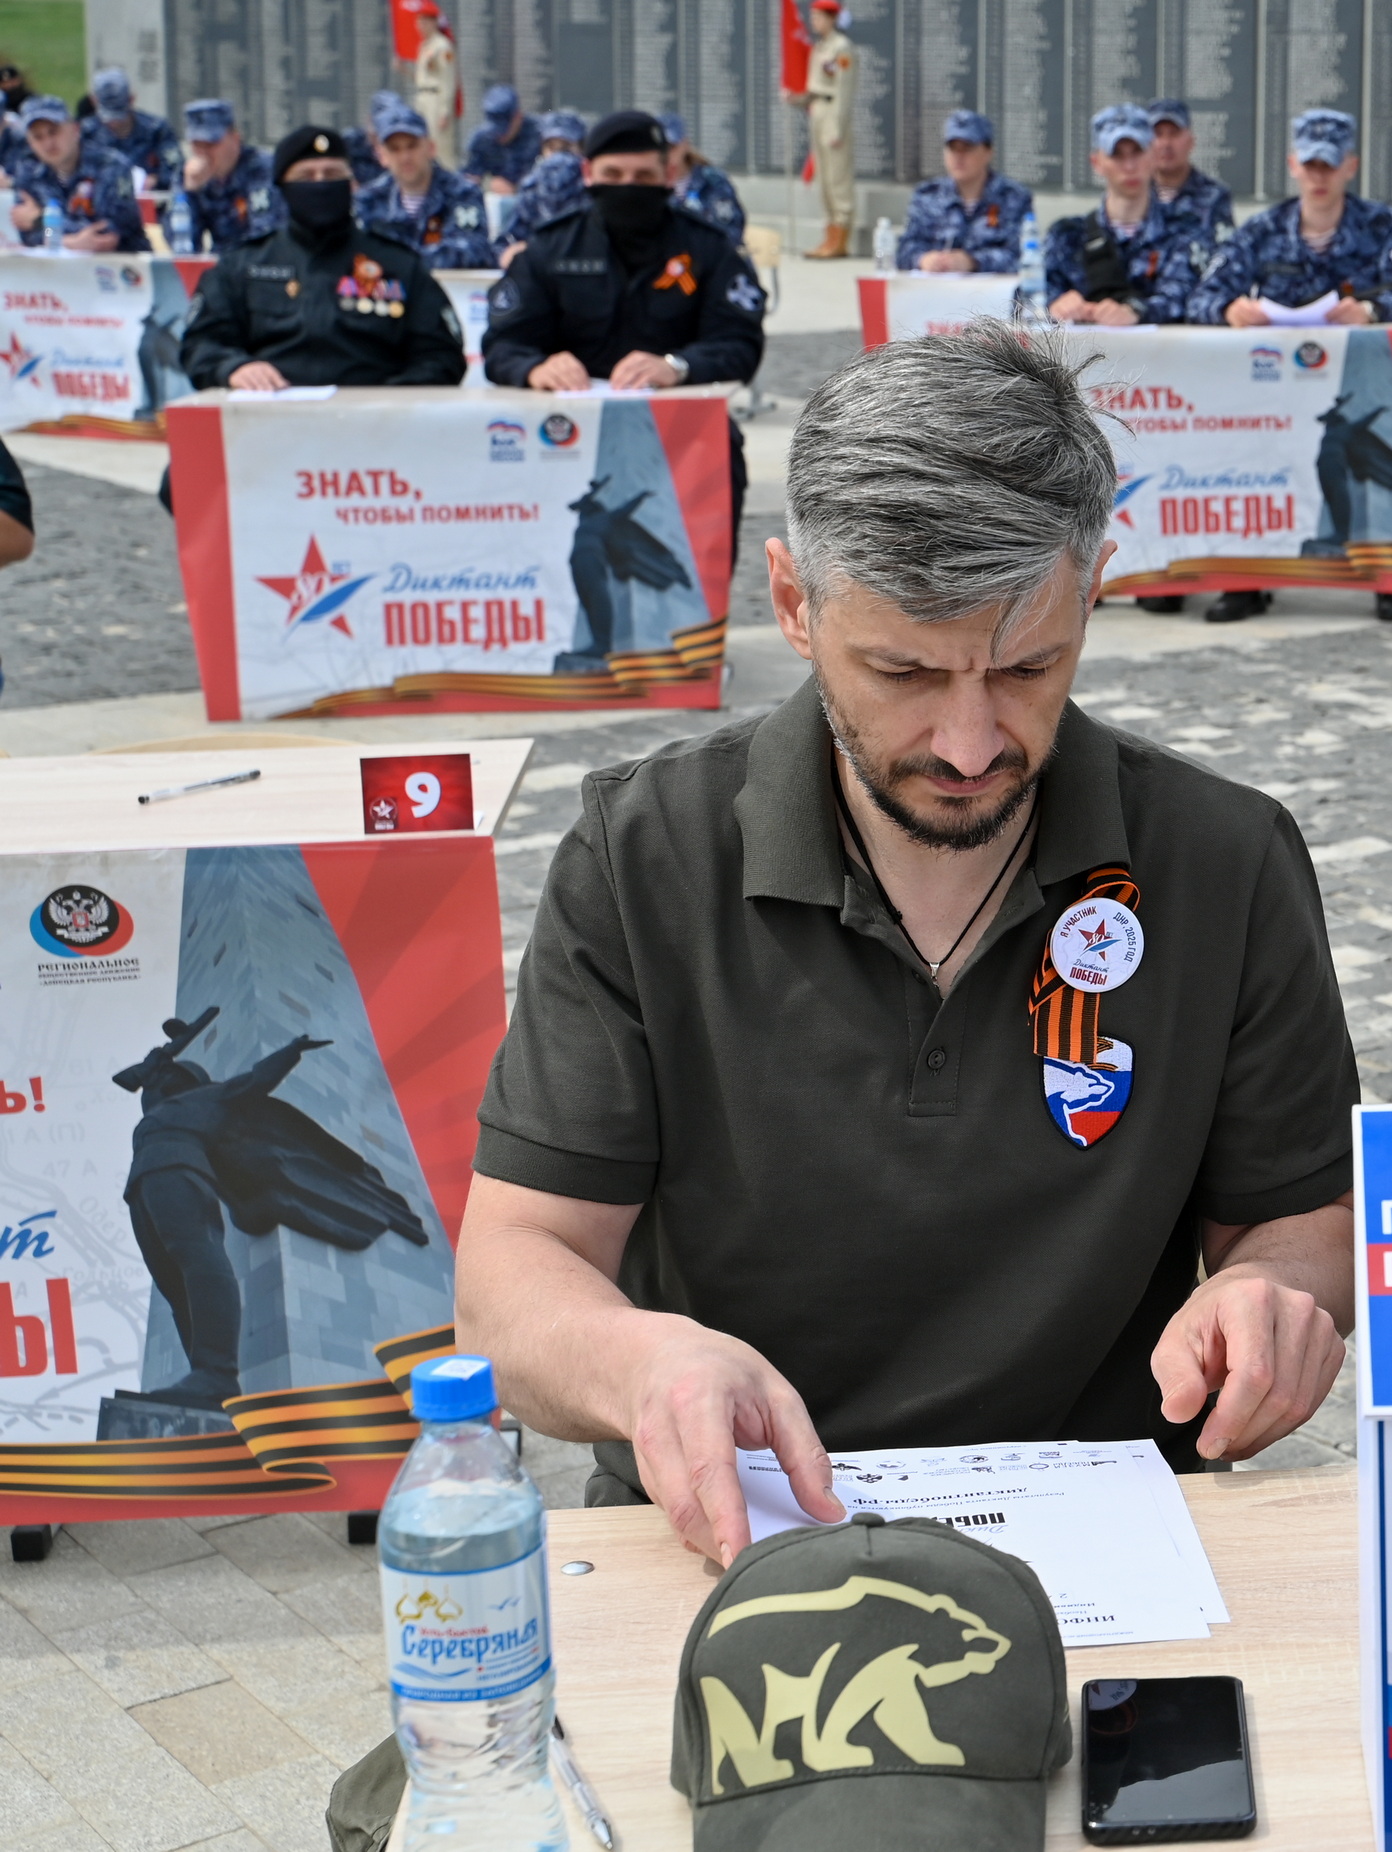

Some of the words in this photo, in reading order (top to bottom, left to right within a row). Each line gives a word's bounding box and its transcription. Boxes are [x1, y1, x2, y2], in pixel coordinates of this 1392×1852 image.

[52, 370, 131, 402] ПОБЕДЫ
[1090, 385, 1195, 413] ЗНАТЬ,
[1192, 414, 1292, 433] ПОМНИТЬ!
[295, 469, 423, 501] ЗНАТЬ,
[1158, 463, 1292, 491] Диктант
[335, 505, 416, 526] ЧТОБЫ
[420, 503, 539, 525] ПОМНИТЬ!
[1161, 494, 1294, 540] ПОБЕДЫ
[382, 561, 541, 594] Диктант
[383, 598, 546, 653] ПОБЕДЫ
[405, 771, 442, 818] 9
[1063, 906, 1098, 932] УЧАСТНИК
[1088, 933, 1105, 945] 80
[1126, 927, 1137, 946] 2025
[37, 957, 140, 972] РЕГИОНАЛЬНОЕ
[1073, 958, 1110, 973] Диктант
[1124, 947, 1136, 963] ГОД
[1069, 966, 1108, 986] ПОБЕДЫ
[402, 1618, 538, 1666] Серебряная
